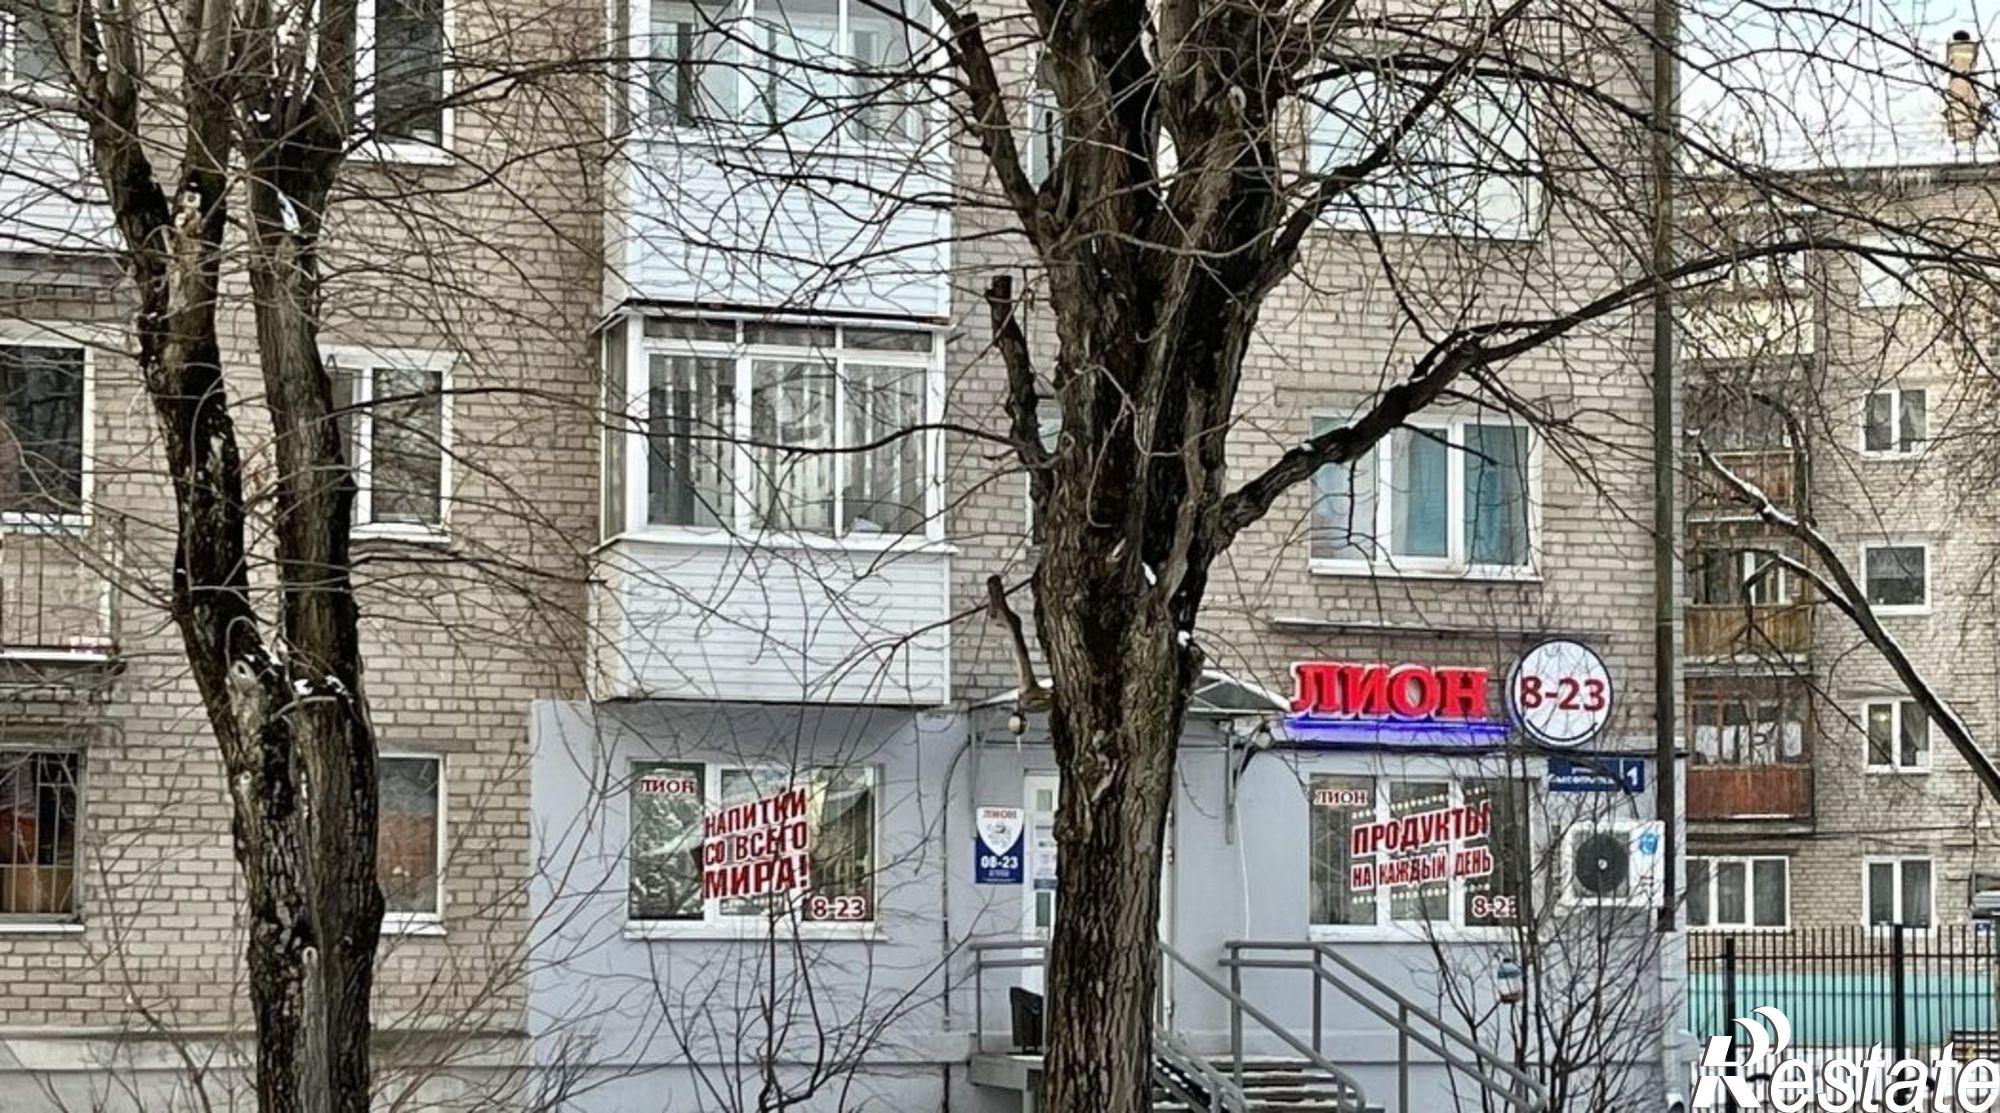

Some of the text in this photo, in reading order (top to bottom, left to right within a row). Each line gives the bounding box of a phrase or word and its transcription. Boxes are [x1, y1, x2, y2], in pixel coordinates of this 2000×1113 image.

[1288, 663, 1488, 721] ЛИОН
[1521, 676, 1605, 712] 8-23
[640, 779, 694, 793] ЛИОН
[1626, 766, 1638, 786] 1
[704, 787, 806, 839] НАПИТКИ
[1314, 790, 1367, 804] ЛИОН
[705, 821, 808, 866] СО ВСЕГО
[1353, 801, 1492, 855] ПРОДУКТЫ
[704, 853, 808, 899] МИРА!
[981, 856, 1018, 869] 08-23
[1352, 848, 1491, 889] НА КАЖДЫЙ ДЕНЬ
[812, 899, 864, 917] 8-23
